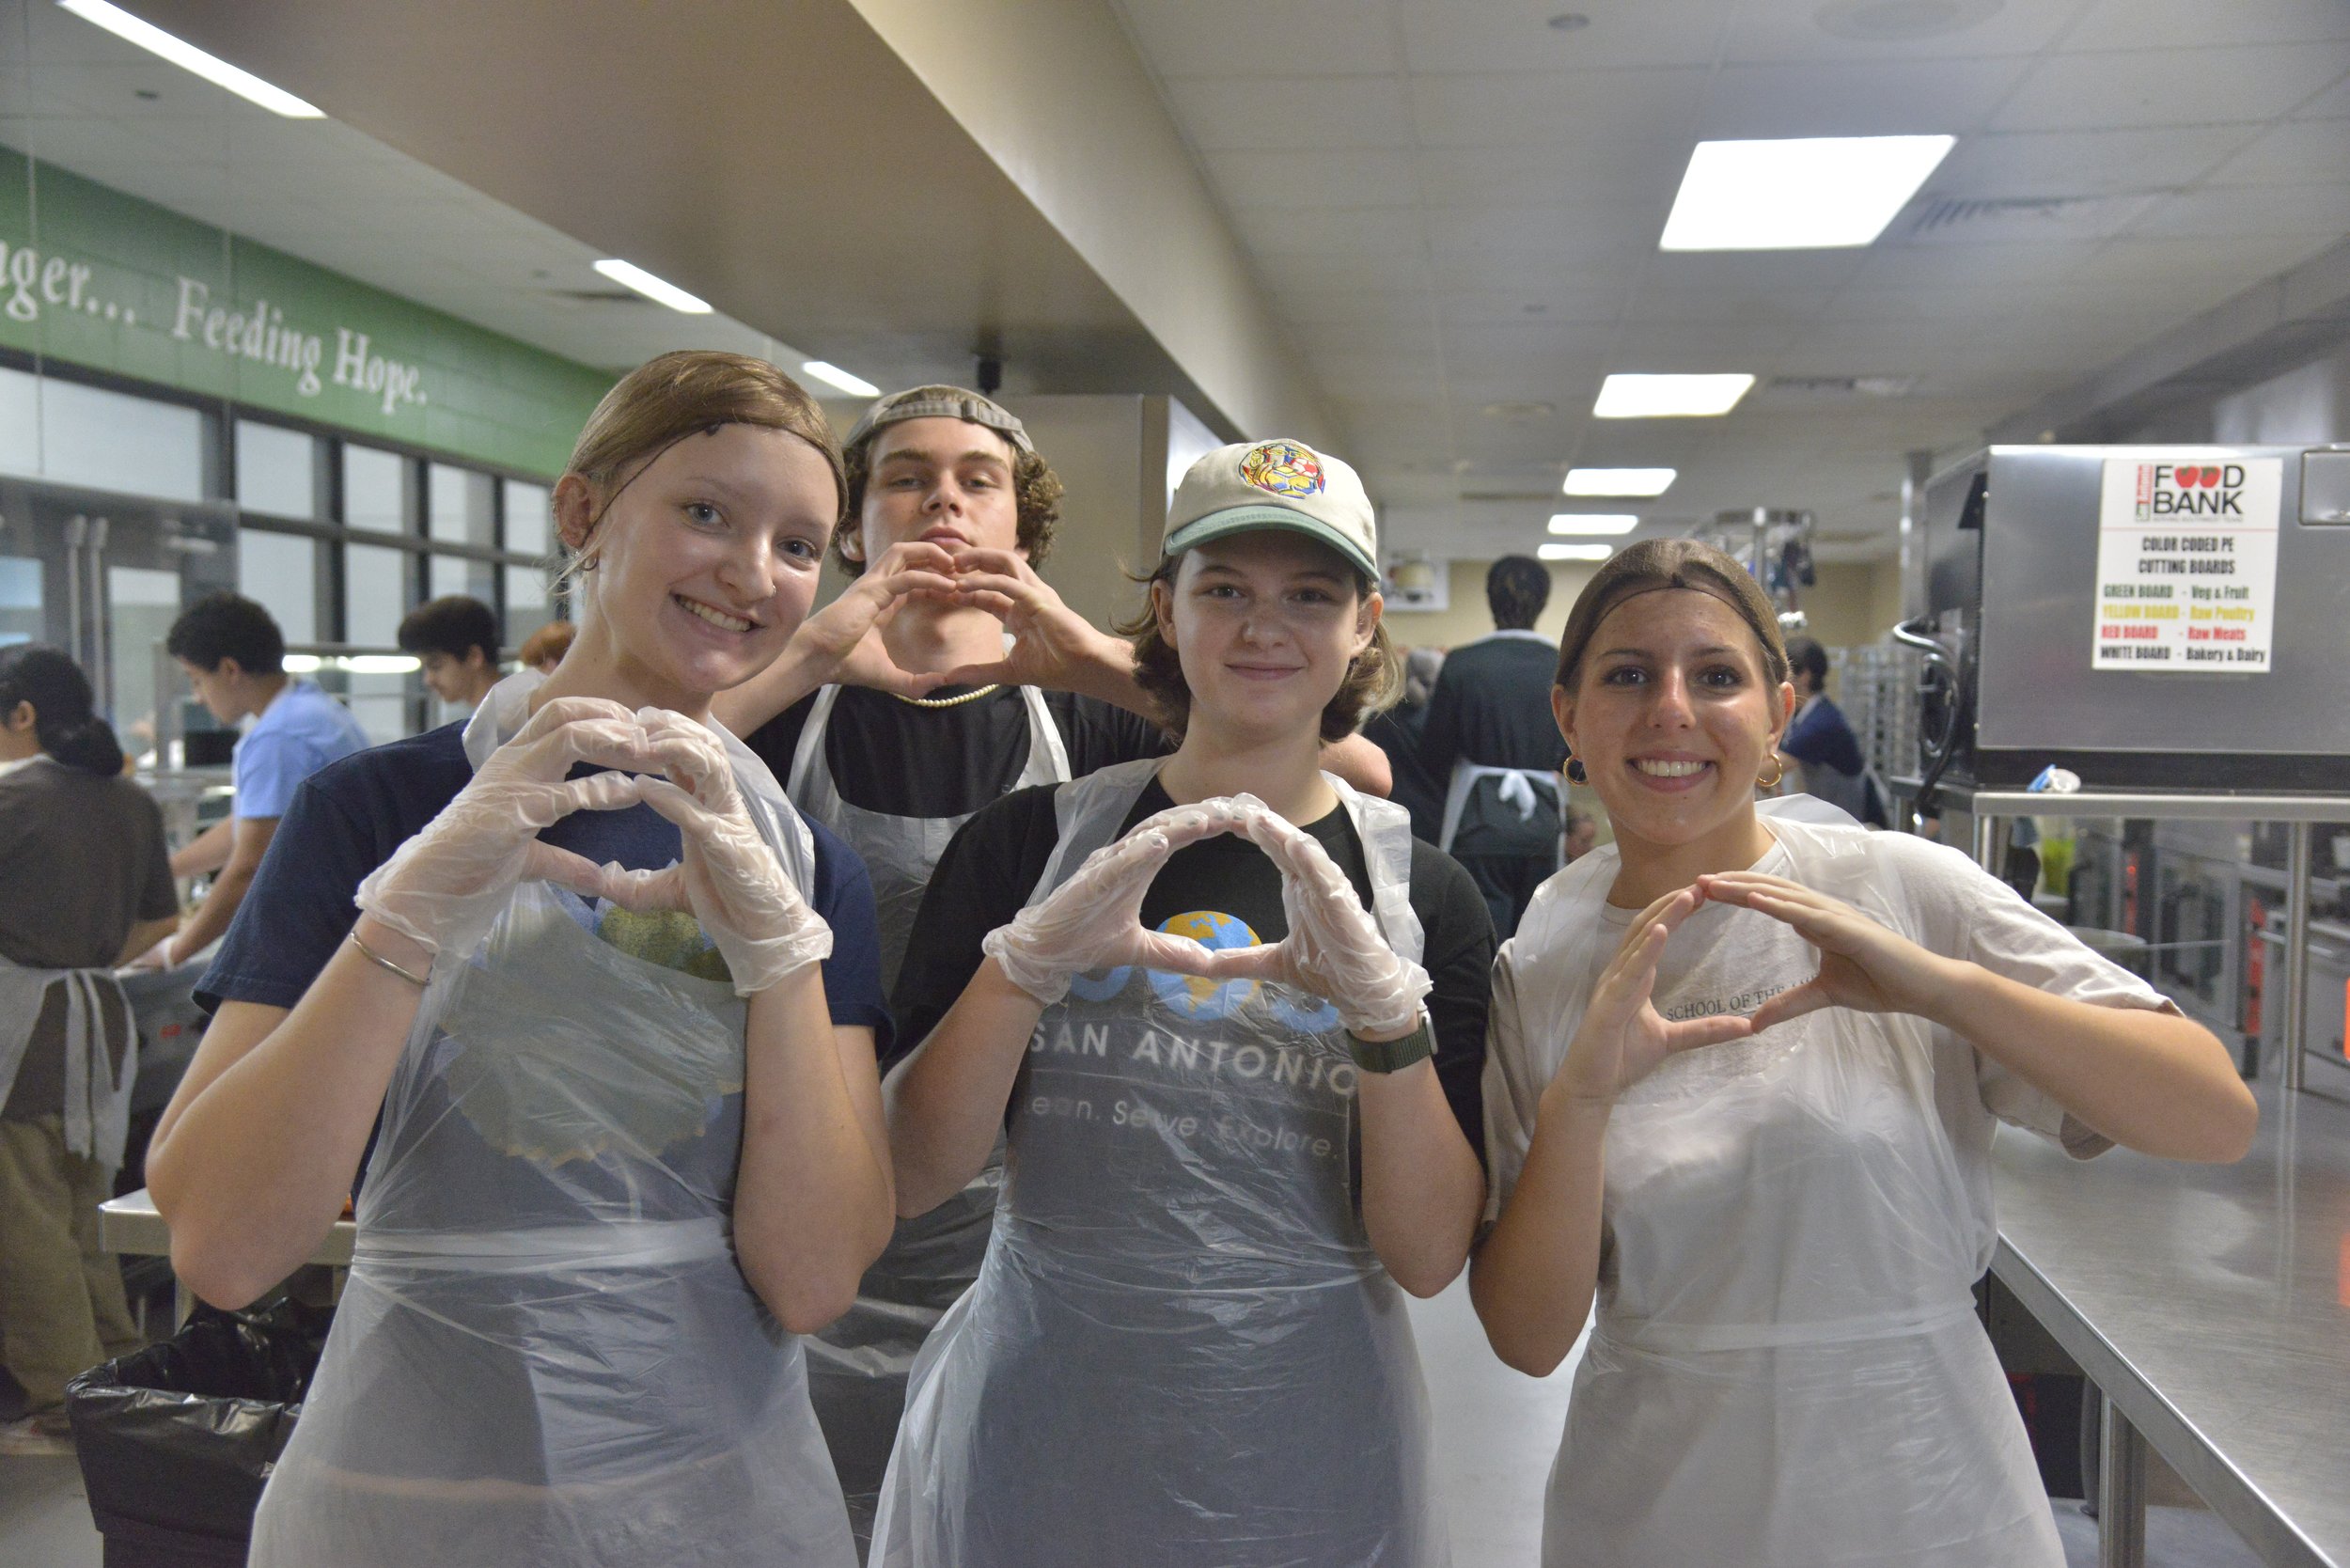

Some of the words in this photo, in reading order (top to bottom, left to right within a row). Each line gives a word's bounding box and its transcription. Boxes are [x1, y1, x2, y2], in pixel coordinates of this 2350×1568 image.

[0, 239, 135, 322] ger...
[173, 276, 321, 397] Feeding
[333, 326, 428, 414] Hope.
[2154, 464, 2246, 489] FOOD
[2153, 491, 2244, 514] BANK
[2142, 537, 2178, 552] COLOR
[2181, 537, 2218, 552] CODED
[2221, 537, 2234, 553] PE
[2138, 559, 2186, 573] CUTTING
[2189, 559, 2235, 574] BOARDS
[2104, 585, 2135, 598] GREEN
[2138, 585, 2173, 599] BOARD
[2191, 586, 2212, 600] Veg
[2224, 586, 2249, 599] Fruit
[2103, 604, 2142, 619] YELLOW
[2144, 604, 2180, 619] BOARD
[2190, 605, 2213, 619] Raw
[2215, 606, 2255, 622] Poultry
[2102, 625, 2121, 639] RED
[2123, 625, 2158, 639] BOARD
[2187, 626, 2210, 640] Raw
[2213, 627, 2246, 640] Meats
[2101, 647, 2133, 659] WHITE
[2135, 647, 2171, 660] BOARD
[2186, 647, 2224, 662] Bakery
[2236, 648, 2266, 663] Dairy
[1668, 999, 1726, 1021] SCHOOL
[1730, 994, 1750, 1011] OF
[1031, 1022, 1109, 1057] SAN
[1132, 1030, 1356, 1095] ANTONIO
[1112, 1100, 1206, 1137] Seve.
